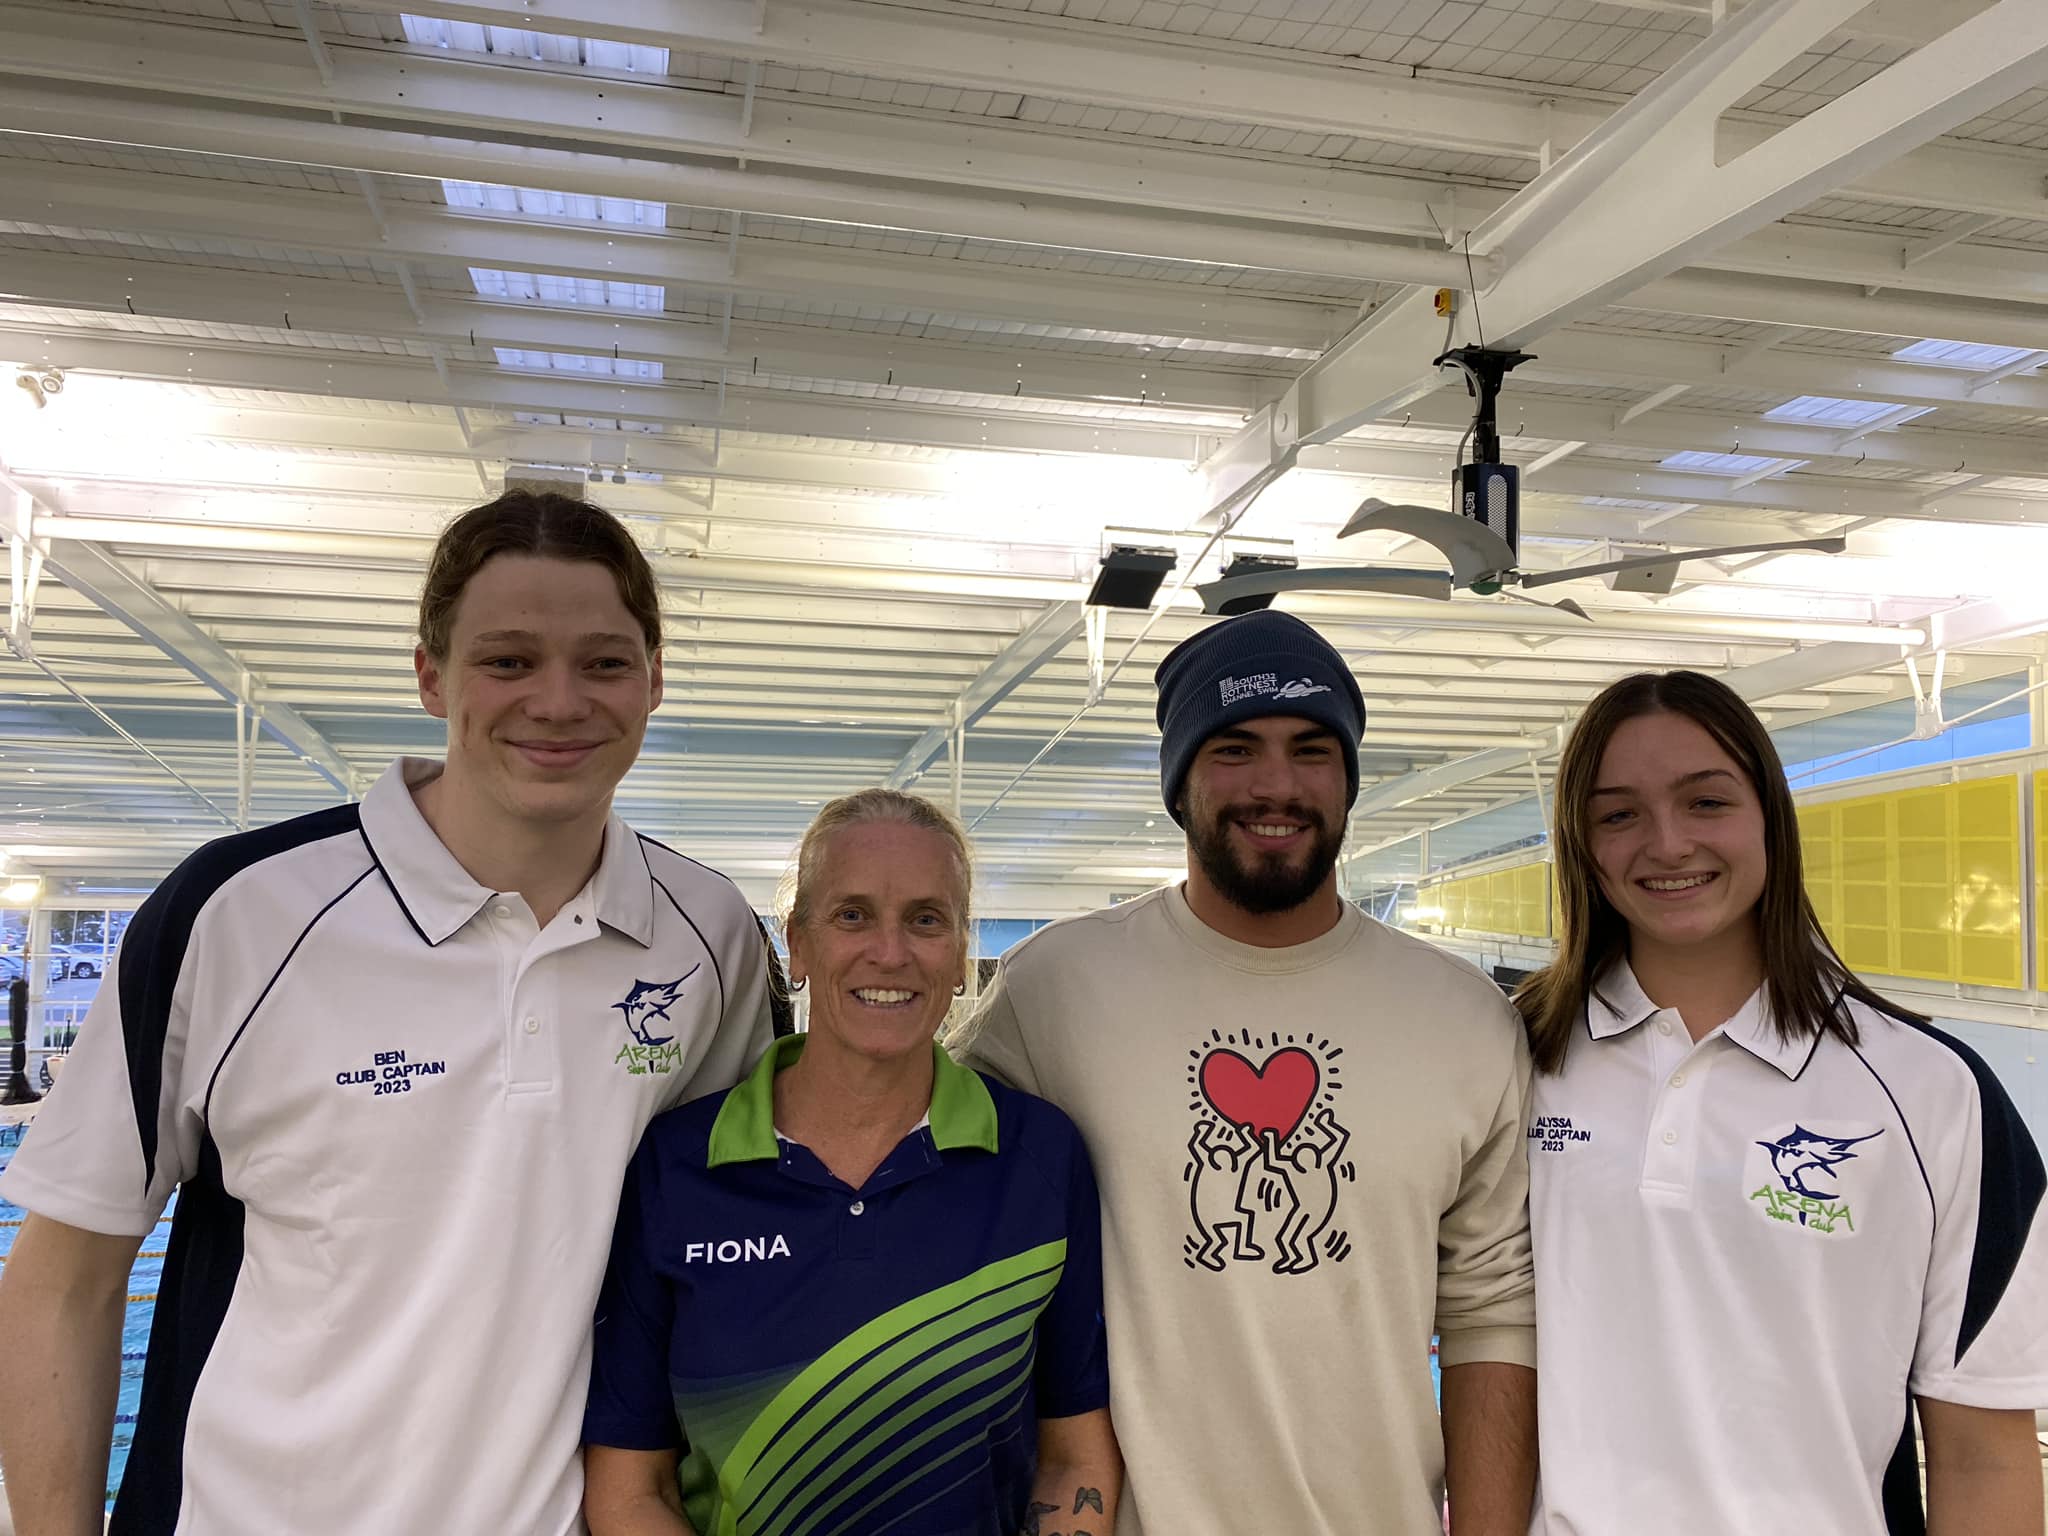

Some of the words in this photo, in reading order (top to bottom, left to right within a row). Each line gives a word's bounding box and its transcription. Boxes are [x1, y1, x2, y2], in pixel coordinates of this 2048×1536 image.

[1233, 672, 1276, 688] SOUTH32
[1221, 679, 1278, 701] ROTTNEST
[1257, 686, 1279, 696] SWIM
[374, 1050, 406, 1066] BEN
[614, 1043, 682, 1066] ARENA
[336, 1069, 377, 1085] CLUB
[382, 1061, 446, 1080] CAPTAIN
[374, 1079, 411, 1095] 2023
[1536, 1116, 1573, 1129] ALYSSA
[1527, 1127, 1545, 1139] LUB
[1548, 1129, 1591, 1142] CAPTAIN
[1541, 1140, 1564, 1152] 2023
[1750, 1184, 1854, 1232] ARENA
[685, 1234, 792, 1264] FIONA
